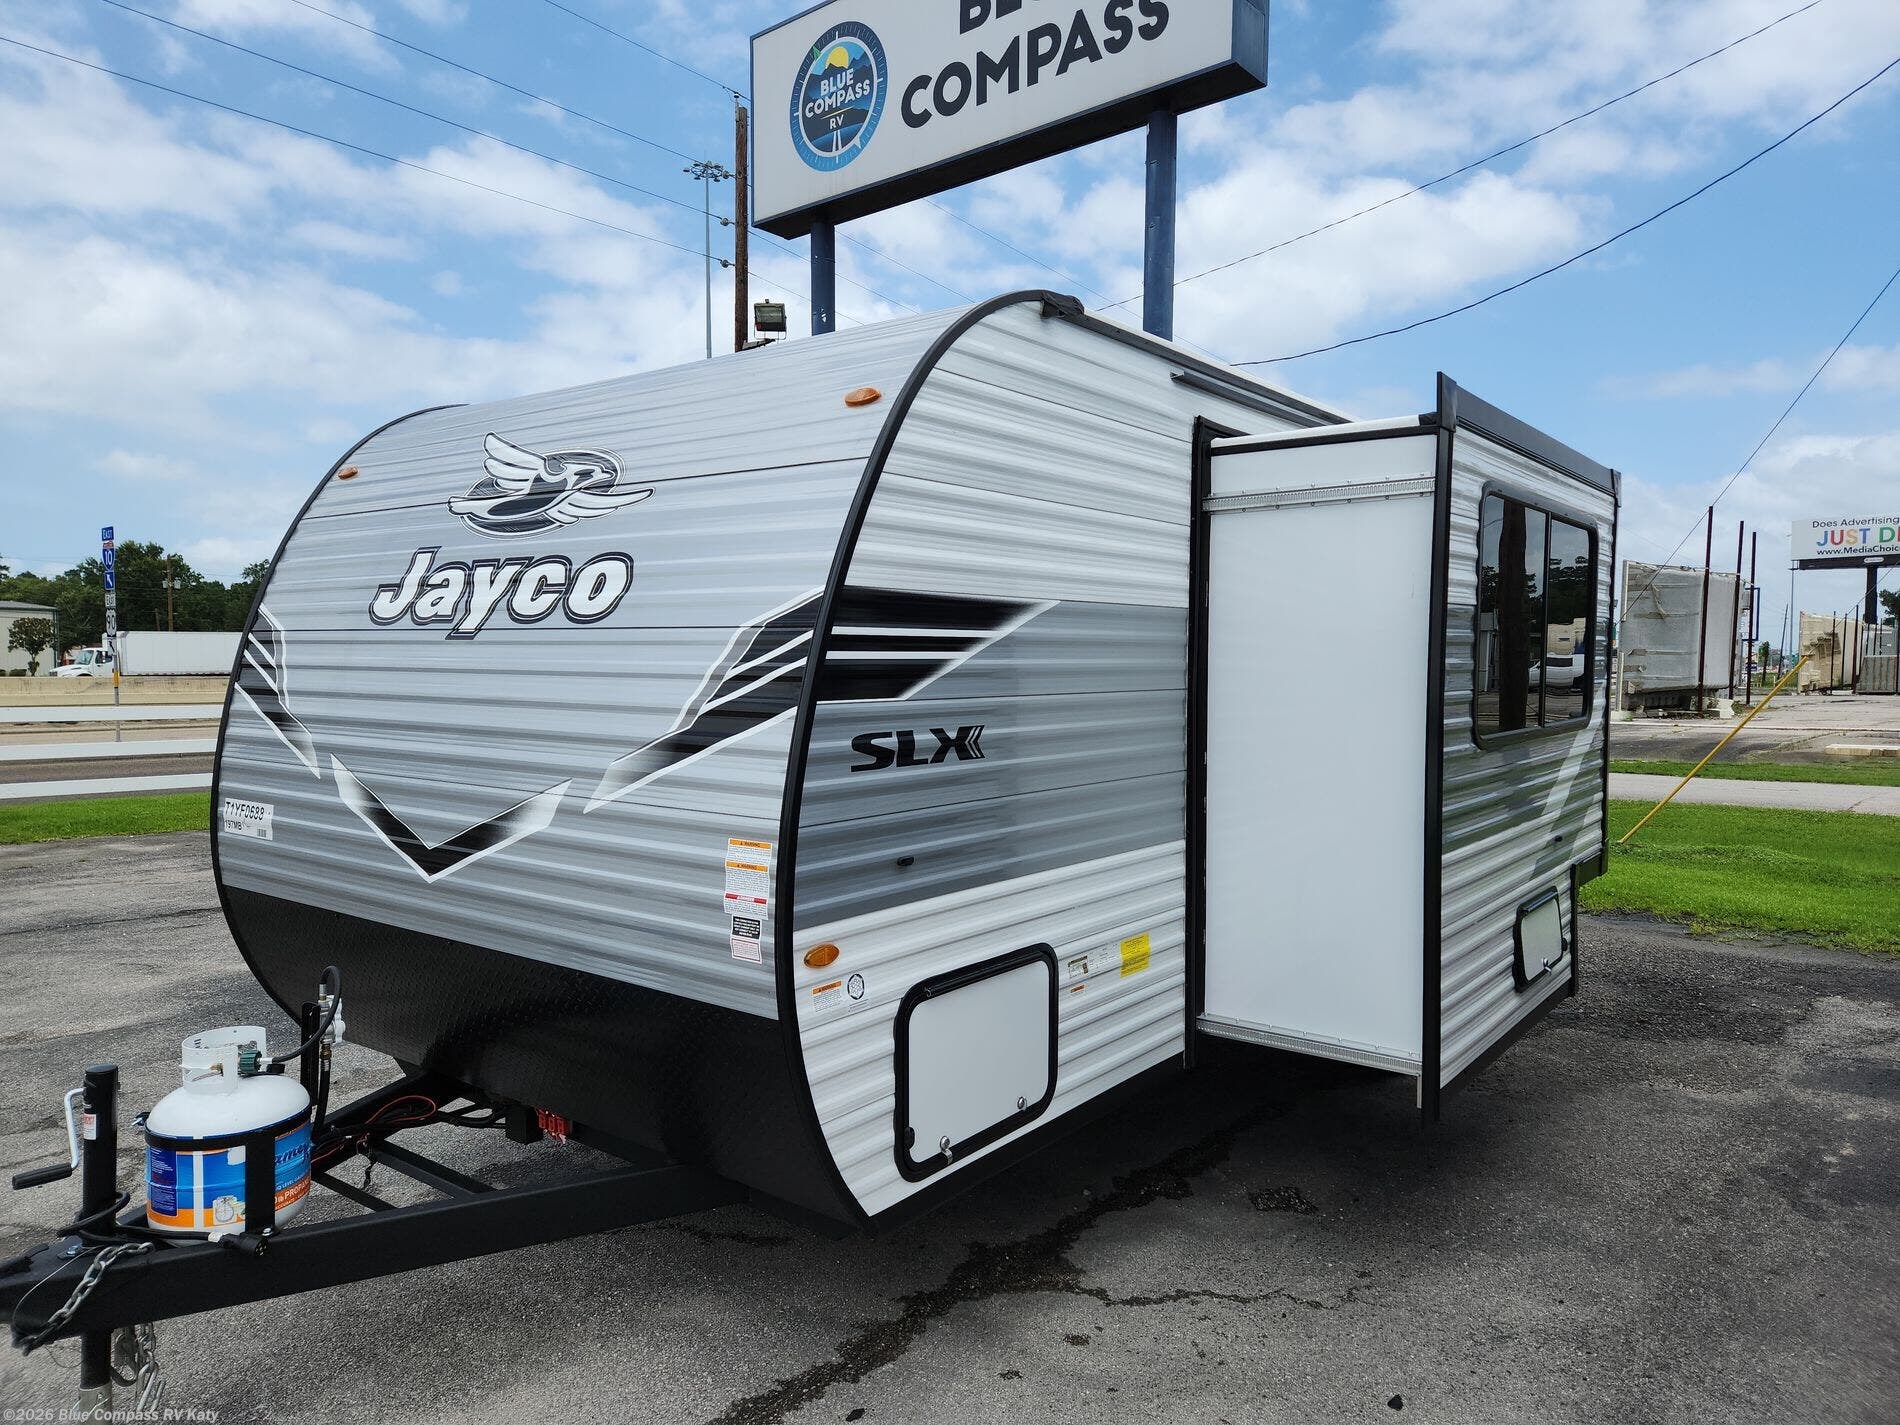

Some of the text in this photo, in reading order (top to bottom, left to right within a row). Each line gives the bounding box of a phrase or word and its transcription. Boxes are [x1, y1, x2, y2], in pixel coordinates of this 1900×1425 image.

[901, 0, 1170, 128] COMPASS
[820, 68, 854, 97] BLUE
[805, 80, 870, 118] COMPASS
[829, 114, 844, 130] RV
[1841, 517, 1900, 526] Advertising
[1817, 528, 1870, 546] JUST
[104, 550, 113, 566] 10
[368, 546, 634, 640] Jayco
[850, 724, 986, 772] SLX
